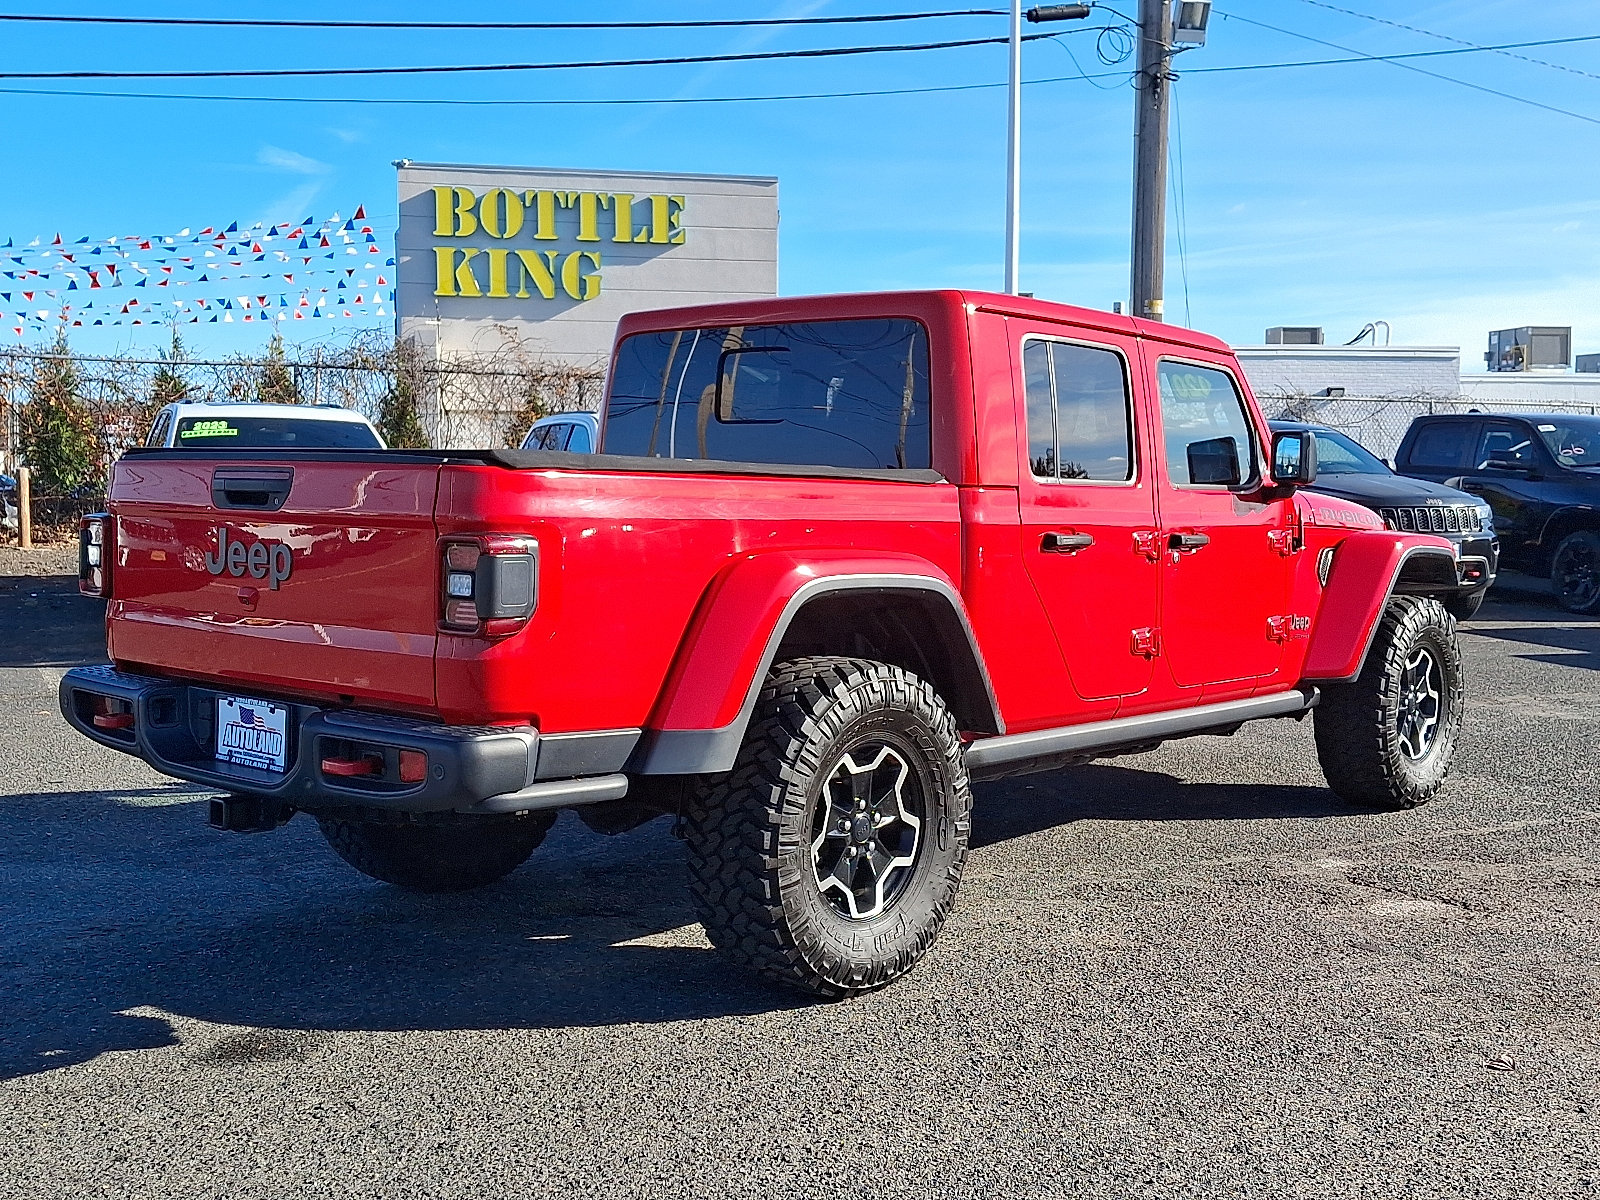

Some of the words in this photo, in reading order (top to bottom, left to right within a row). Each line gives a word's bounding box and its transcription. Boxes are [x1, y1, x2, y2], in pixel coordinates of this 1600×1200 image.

[432, 185, 686, 245] BOTTLE
[433, 246, 603, 301] KING
[193, 421, 228, 430] 2023
[1425, 497, 1443, 506] Jeep
[1318, 507, 1381, 526] RUBICON
[205, 527, 292, 590] Jeep
[1289, 613, 1311, 631] Jeep
[223, 725, 283, 756] AUTOLAND
[231, 756, 268, 769] AUTOLAND
